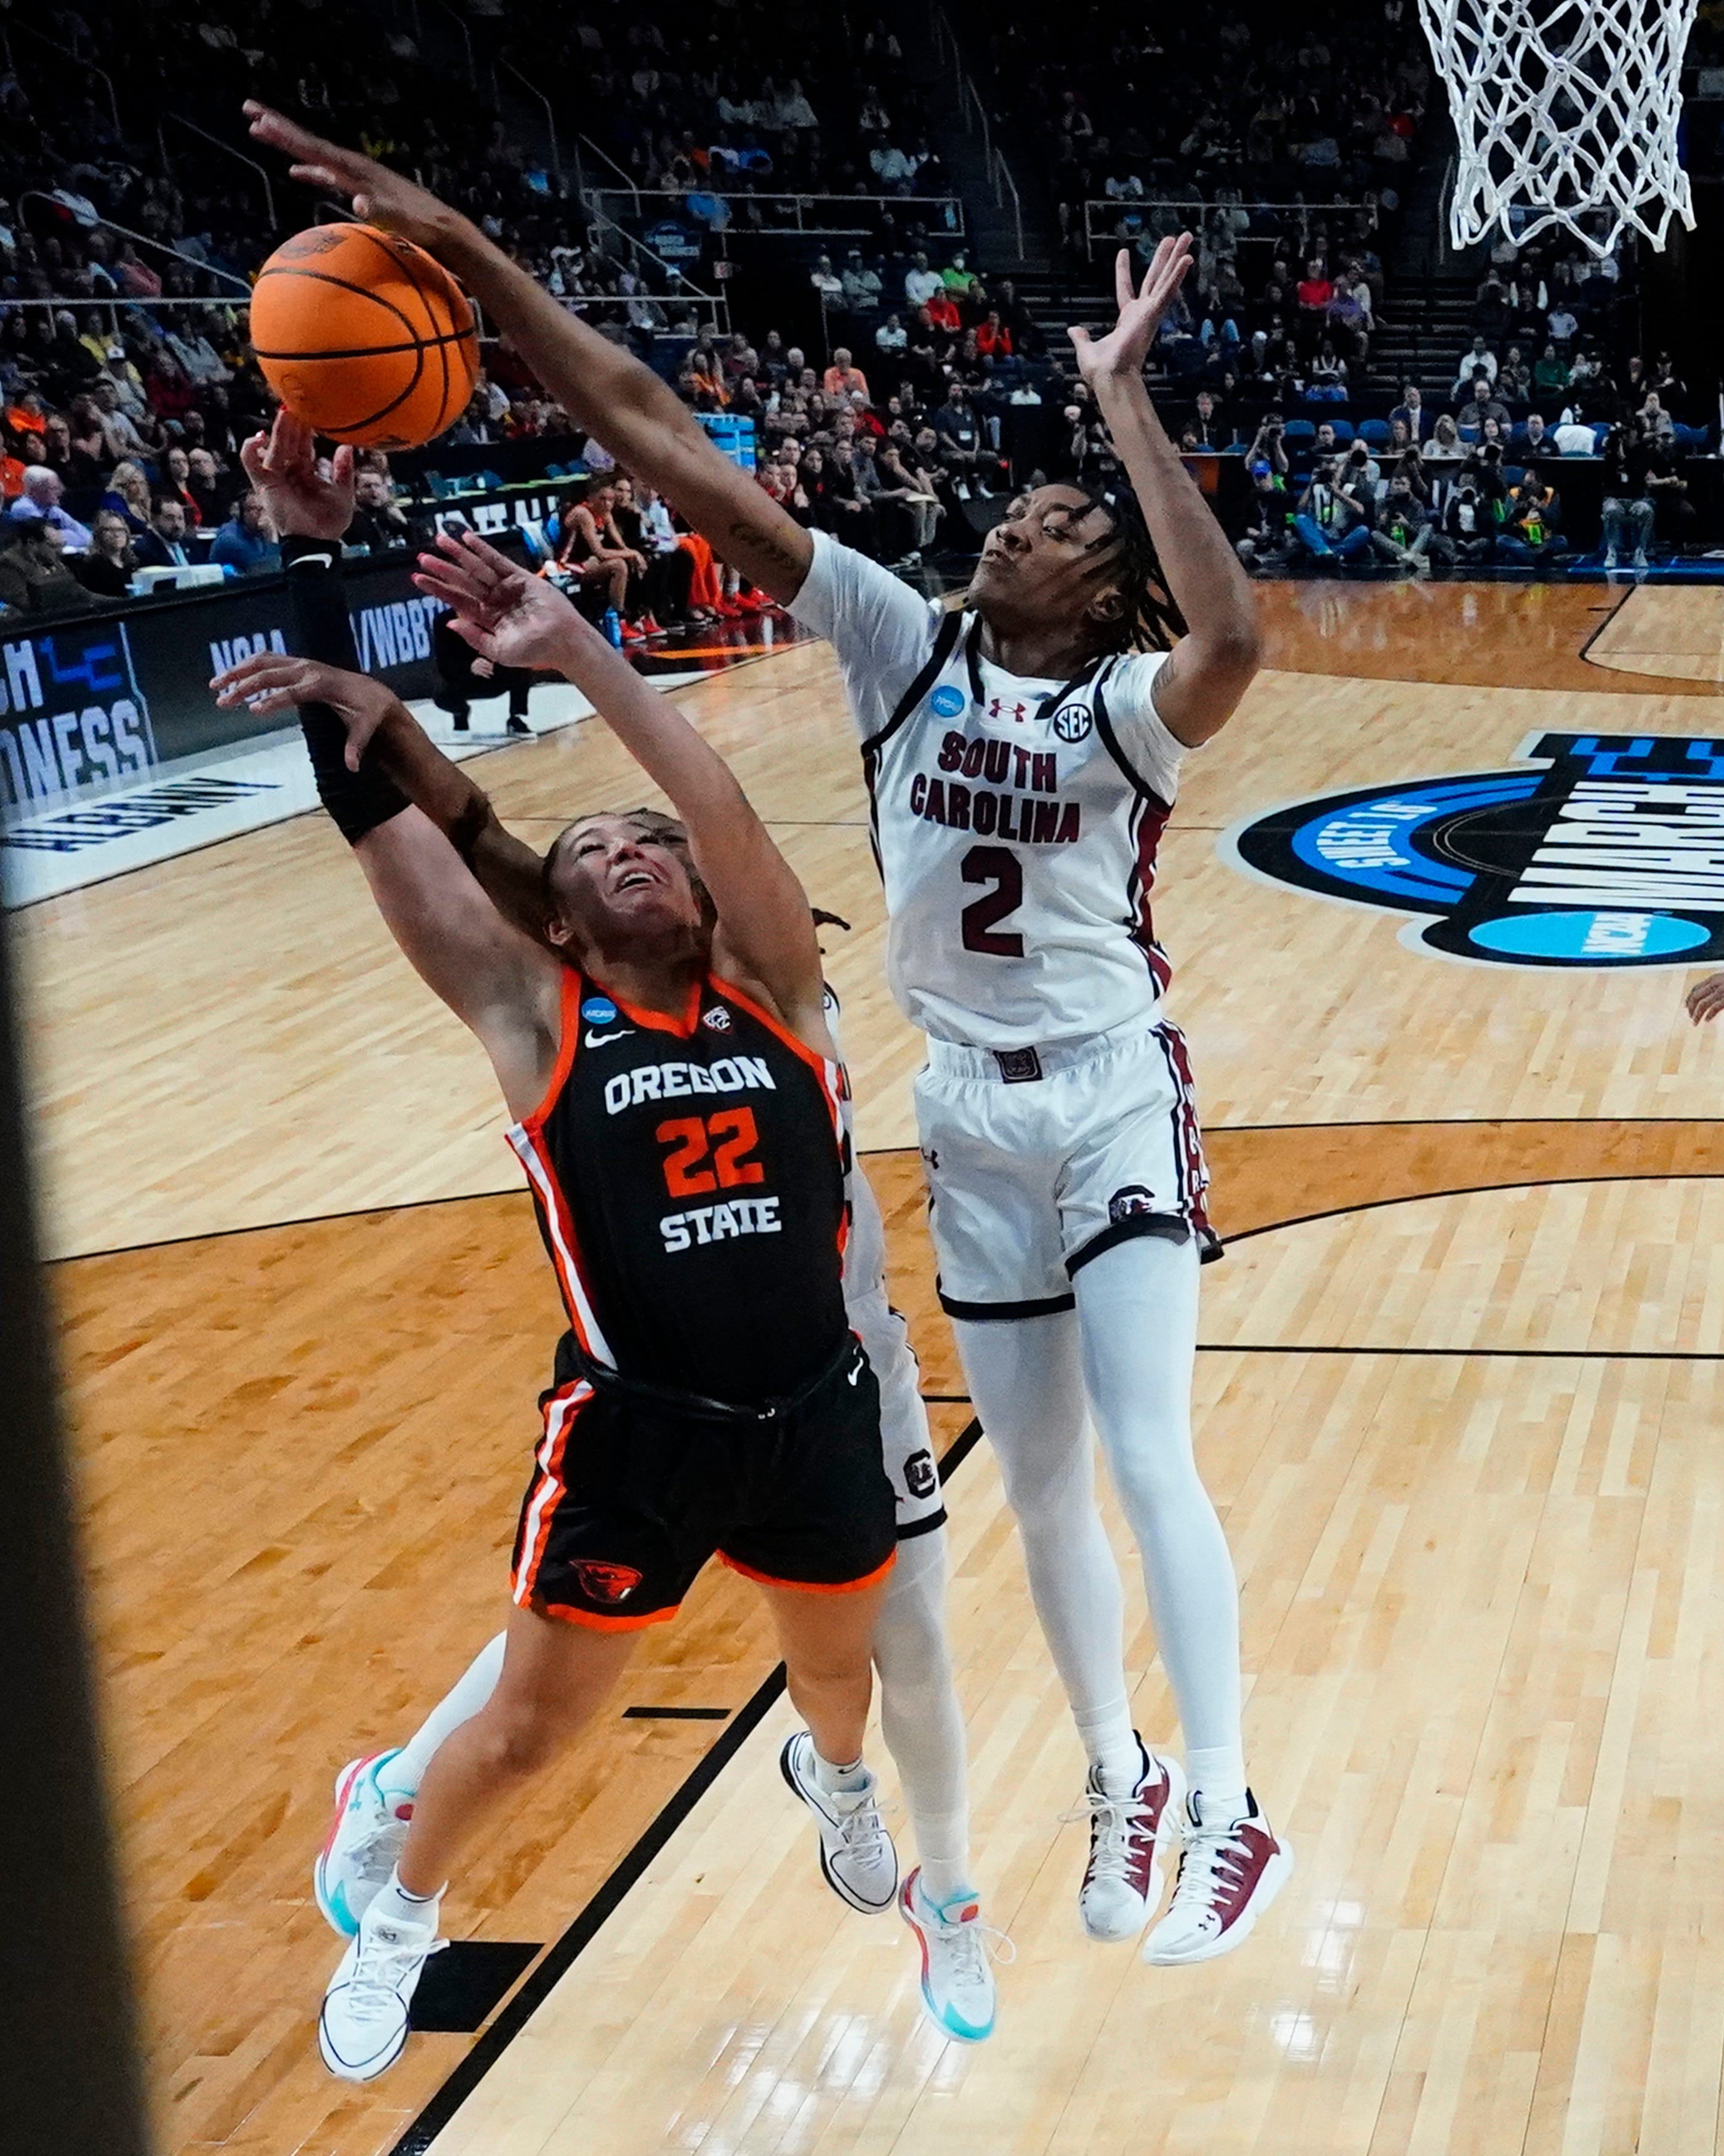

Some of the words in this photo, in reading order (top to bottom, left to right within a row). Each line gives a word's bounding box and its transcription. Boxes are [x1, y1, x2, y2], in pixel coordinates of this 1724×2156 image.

[1057, 706, 1089, 739] SEC
[937, 730, 1057, 794] SOUTH
[910, 773, 1080, 843] CAROLINA
[1347, 800, 1438, 821] 16
[1316, 821, 1411, 868] SWEET
[1507, 781, 1724, 912] MARCH
[961, 845, 1025, 958] 2
[1581, 911, 1658, 954] NCAA
[604, 1056, 777, 1116] OREGON
[655, 1106, 765, 1198] 22
[659, 1196, 782, 1253] STATE
